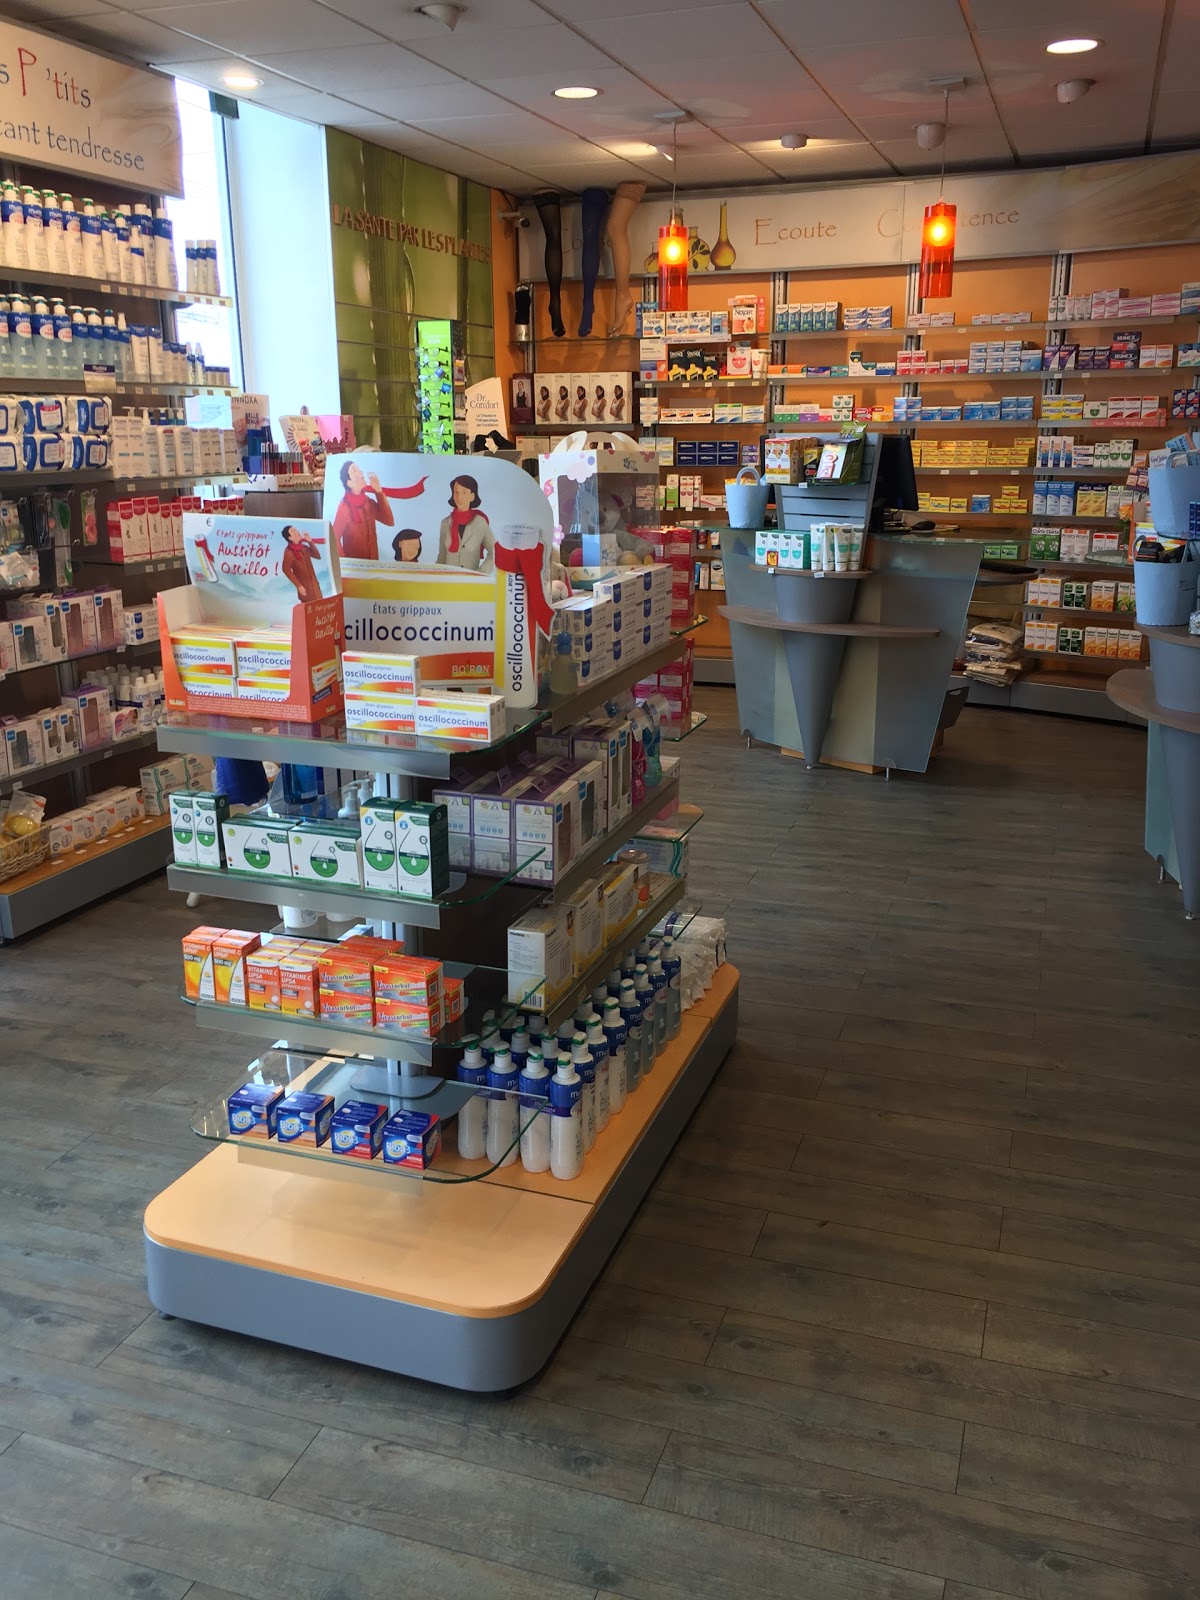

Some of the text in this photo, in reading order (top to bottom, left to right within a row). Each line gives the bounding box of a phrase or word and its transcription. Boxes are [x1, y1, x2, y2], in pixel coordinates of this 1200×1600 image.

[46, 125, 145, 171] tendresse
[333, 203, 354, 231] LA
[753, 217, 838, 246] Ecoute
[470, 400, 499, 409] Comfort
[217, 541, 271, 559] Aussitôt
[220, 561, 269, 577] Oscillo
[373, 601, 442, 617] États grippaux
[345, 669, 413, 682] oscillococcinum
[347, 708, 415, 721] oscillococcinum
[418, 714, 488, 728] oscillococcinum
[247, 966, 273, 975] VITAMINE
[280, 971, 306, 980] VITAMINE
[281, 977, 296, 985] UPSA
